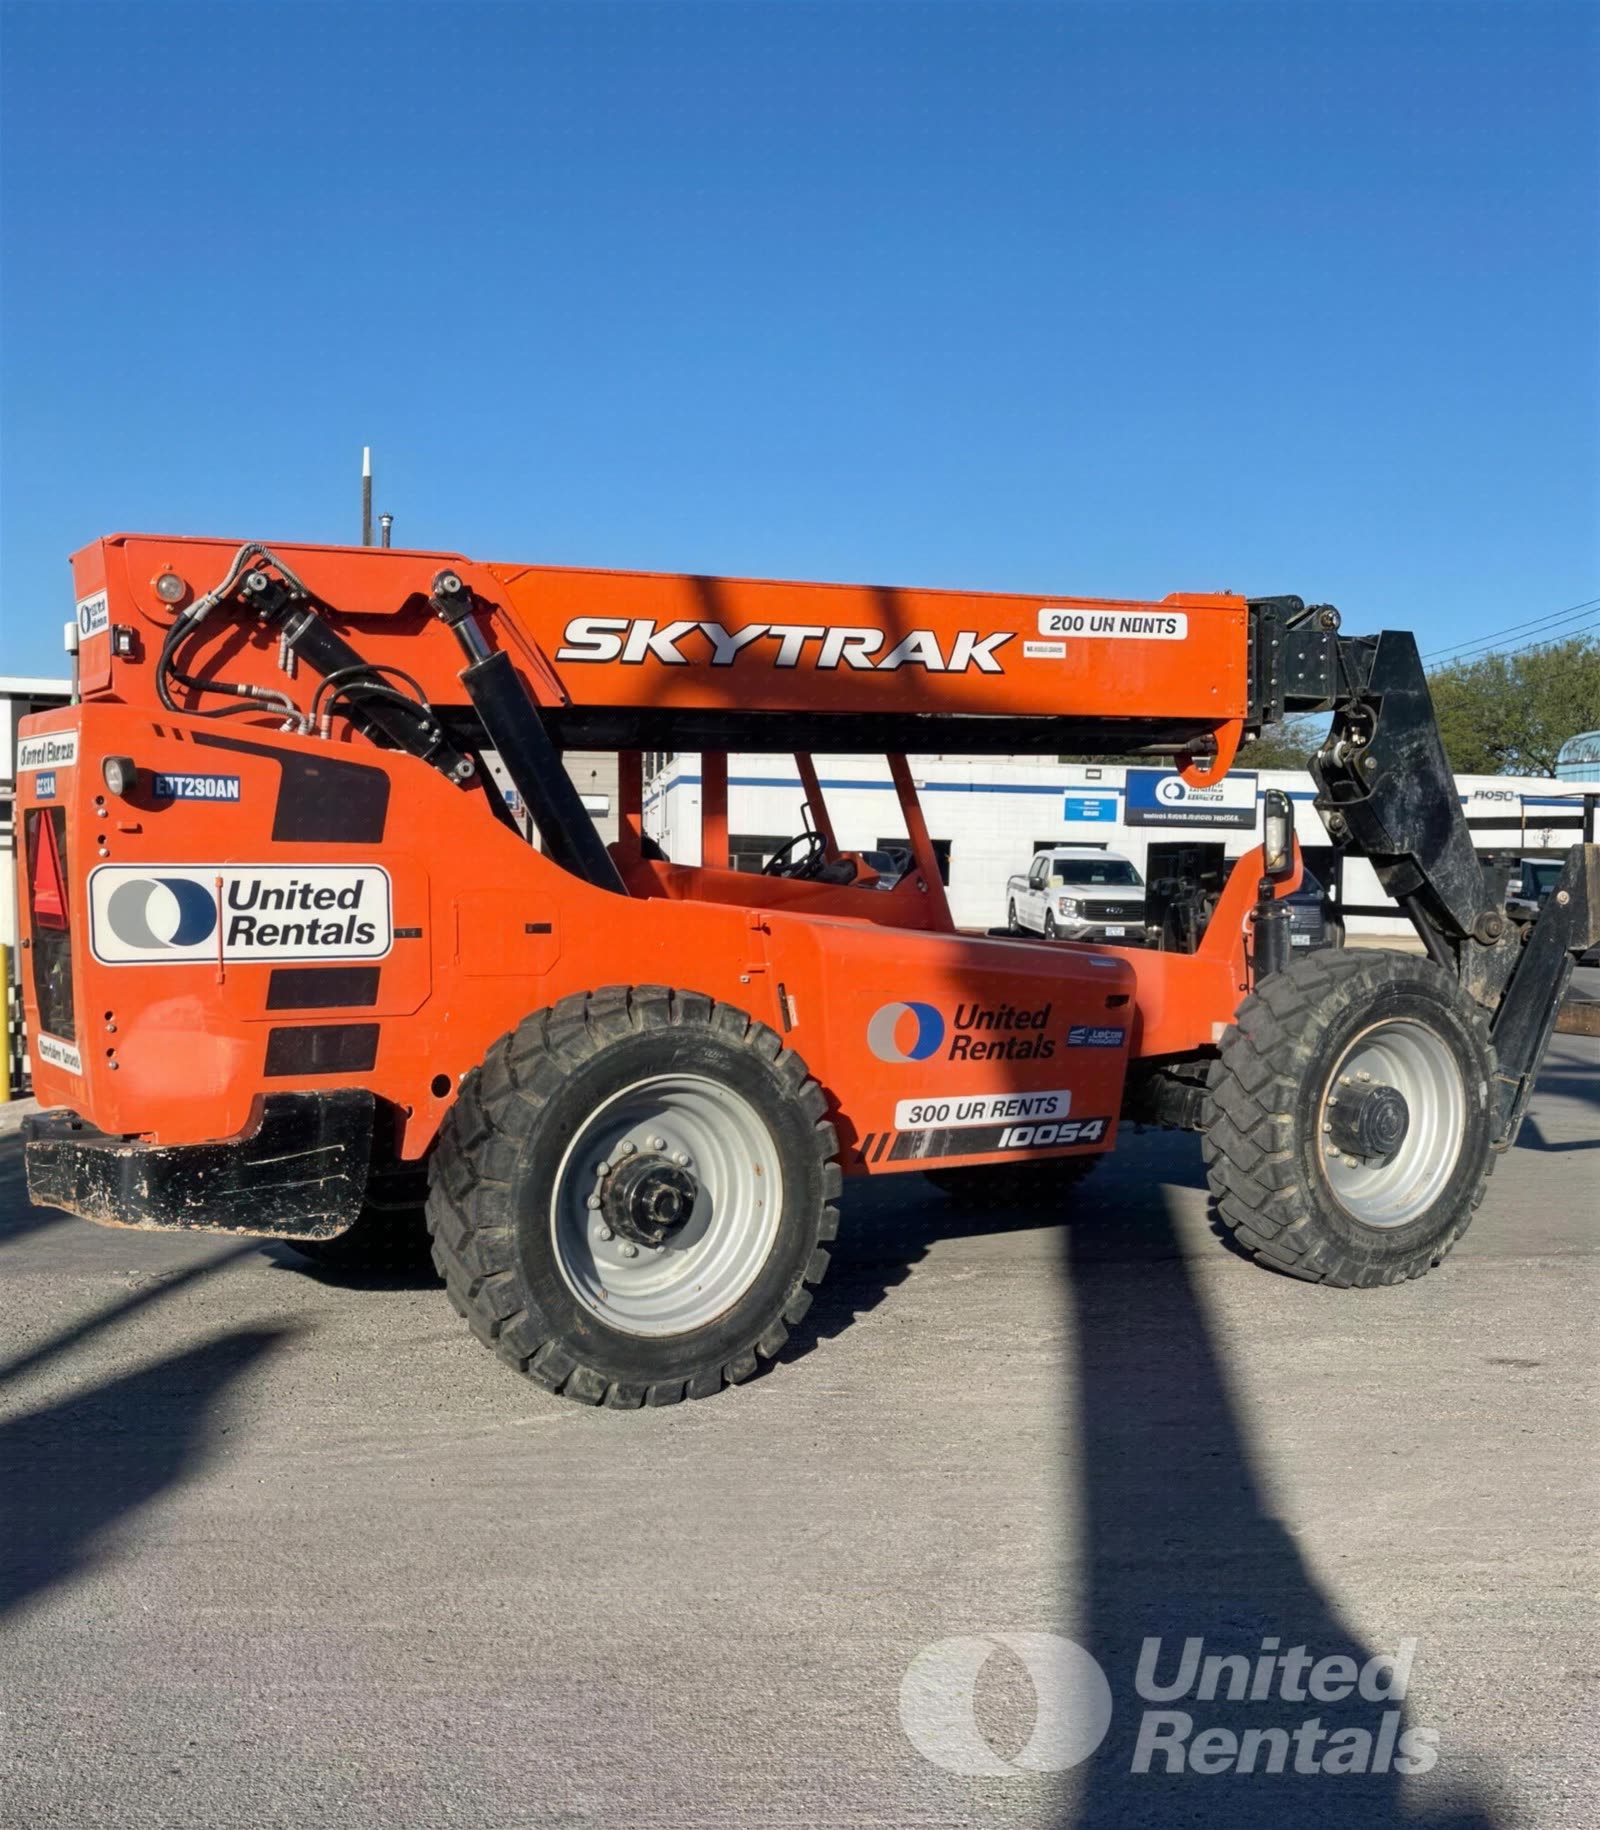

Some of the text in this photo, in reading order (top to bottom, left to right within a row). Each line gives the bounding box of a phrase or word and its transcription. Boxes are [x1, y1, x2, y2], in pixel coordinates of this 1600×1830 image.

[1050, 615, 1084, 631] 200
[556, 616, 1018, 673] SKYTRAK
[228, 879, 364, 911] United
[227, 914, 376, 946] Rentals
[954, 1003, 1052, 1030] United
[948, 1033, 1056, 1061] Rentals
[908, 1096, 1059, 1124] 300 UR RENTS
[998, 1119, 1104, 1148] 10054
